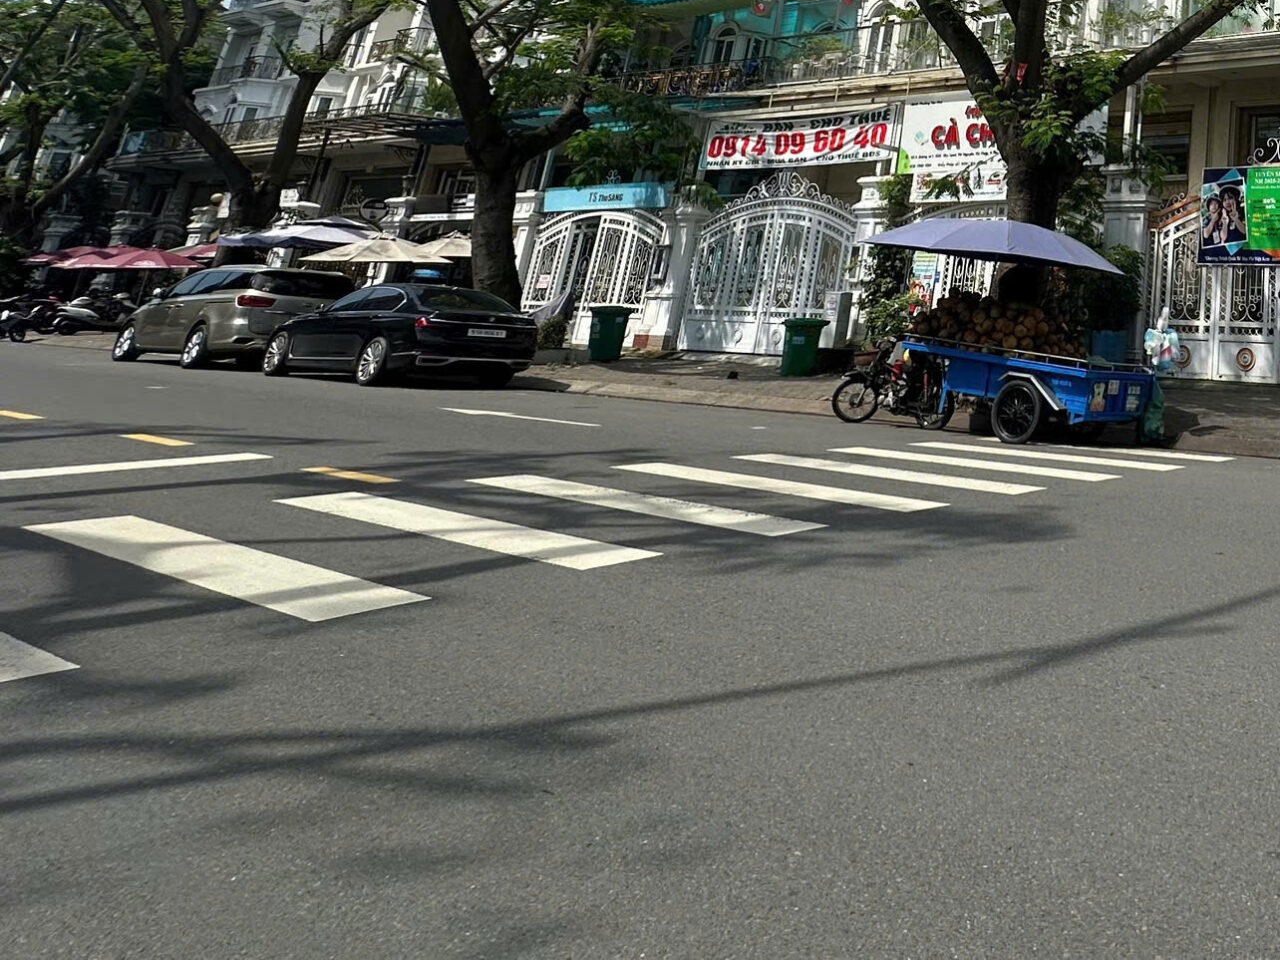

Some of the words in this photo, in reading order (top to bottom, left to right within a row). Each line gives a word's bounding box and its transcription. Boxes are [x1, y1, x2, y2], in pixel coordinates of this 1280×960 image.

[810, 117, 843, 129] CHO
[849, 108, 891, 125] THUÊ
[774, 131, 805, 155] 09
[813, 128, 846, 152] 60
[854, 123, 887, 149] 40
